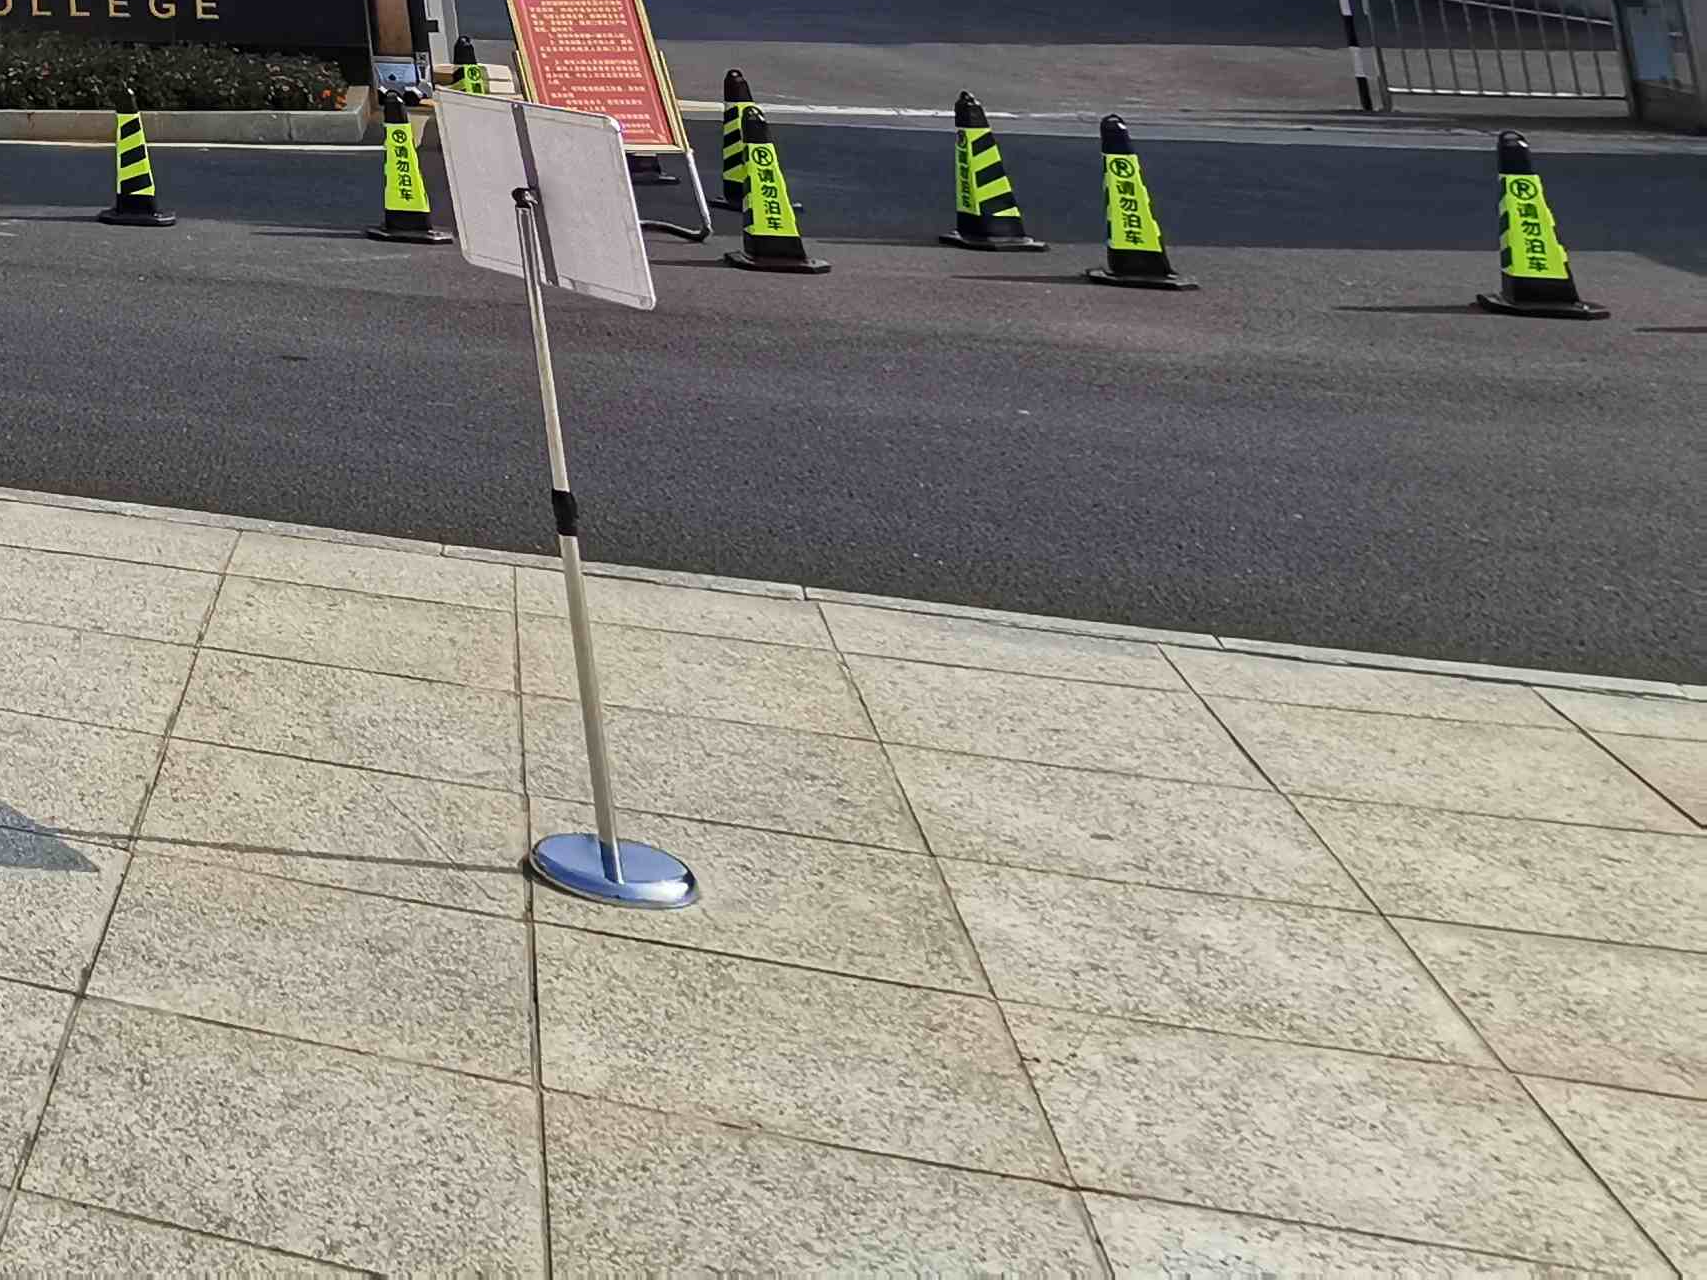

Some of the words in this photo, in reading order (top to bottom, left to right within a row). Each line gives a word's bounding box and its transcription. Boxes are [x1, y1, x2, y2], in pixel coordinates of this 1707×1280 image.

[394, 145, 414, 200] 请勿泊车
[757, 167, 784, 230] 请勿泊车
[1116, 180, 1146, 245] 请勿泊车
[1517, 201, 1548, 272] 请勿泊车
